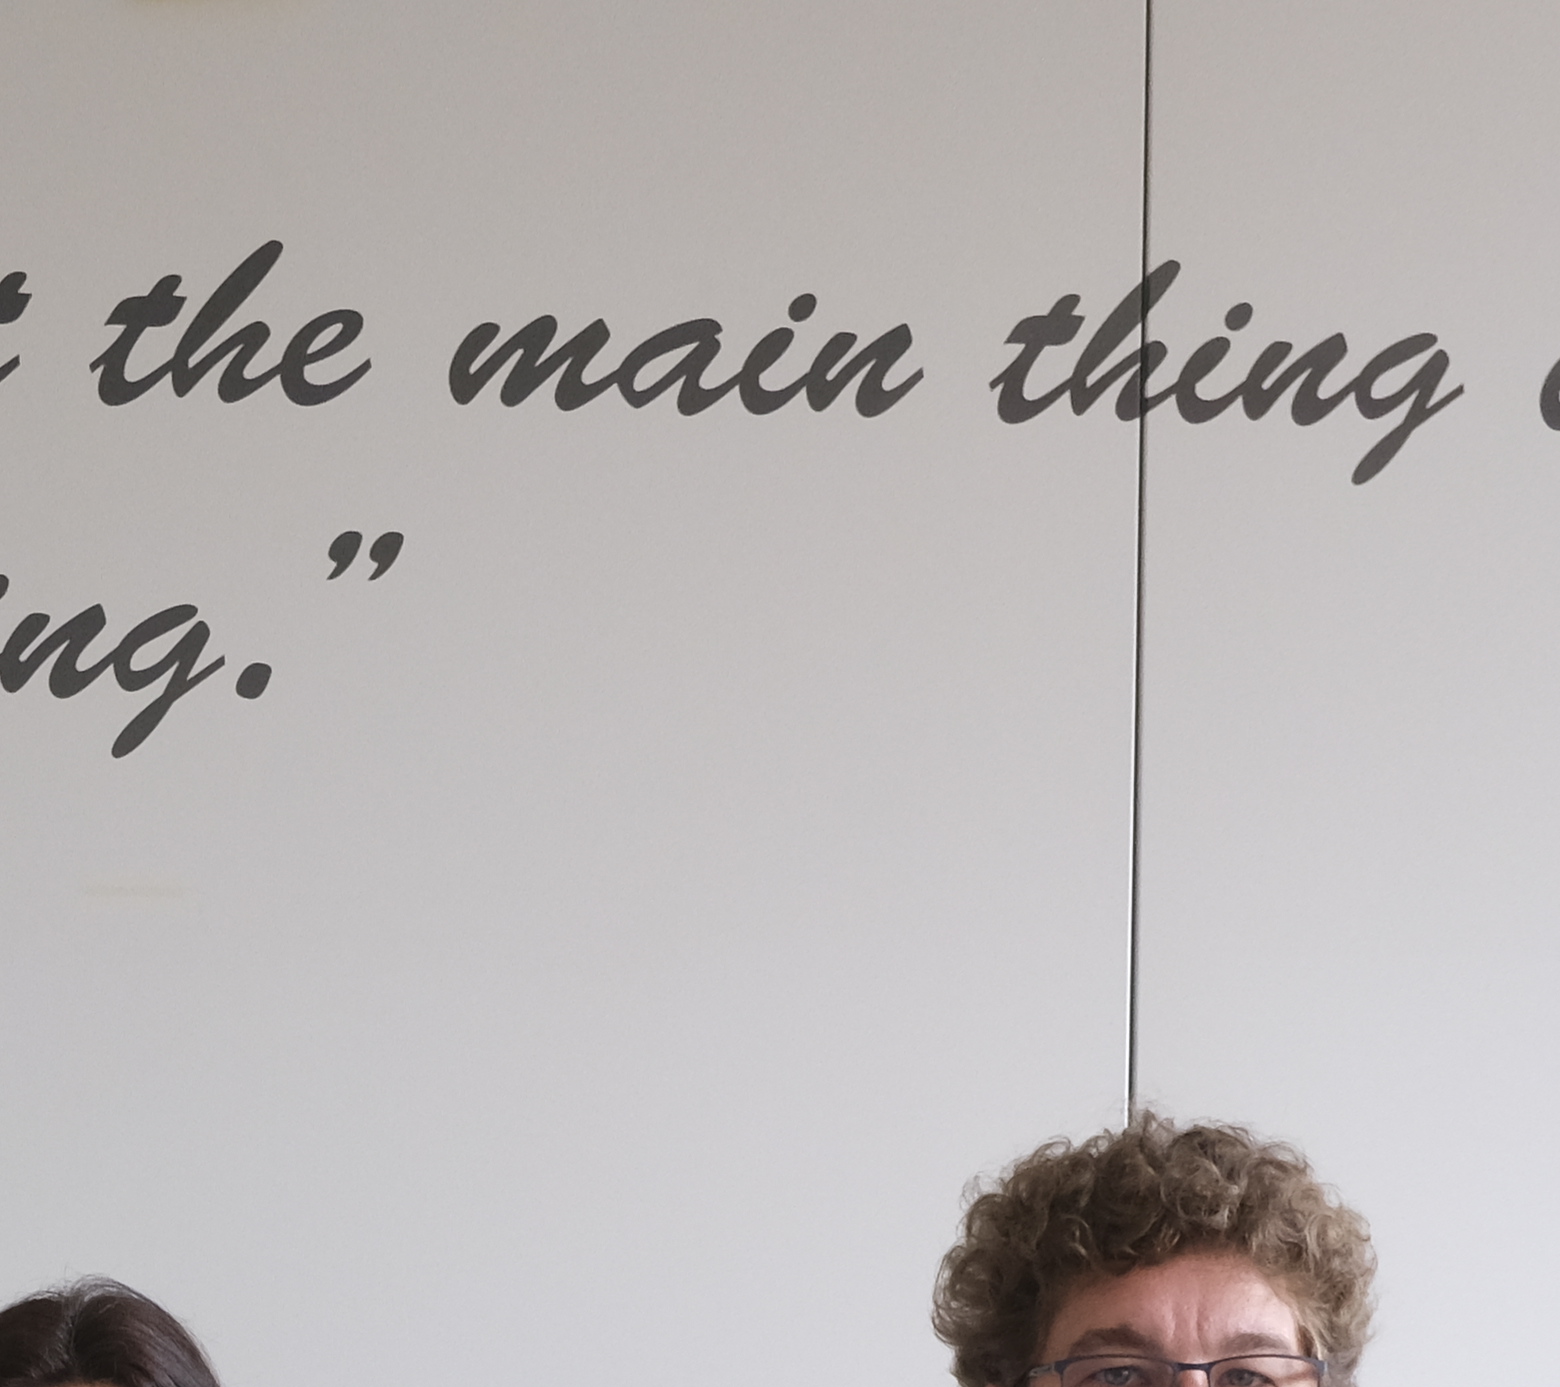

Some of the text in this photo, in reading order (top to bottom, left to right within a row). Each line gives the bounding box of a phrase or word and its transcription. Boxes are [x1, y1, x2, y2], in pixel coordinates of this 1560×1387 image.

[89, 239, 372, 407] the
[448, 292, 924, 418] main
[988, 258, 1465, 486] thing
